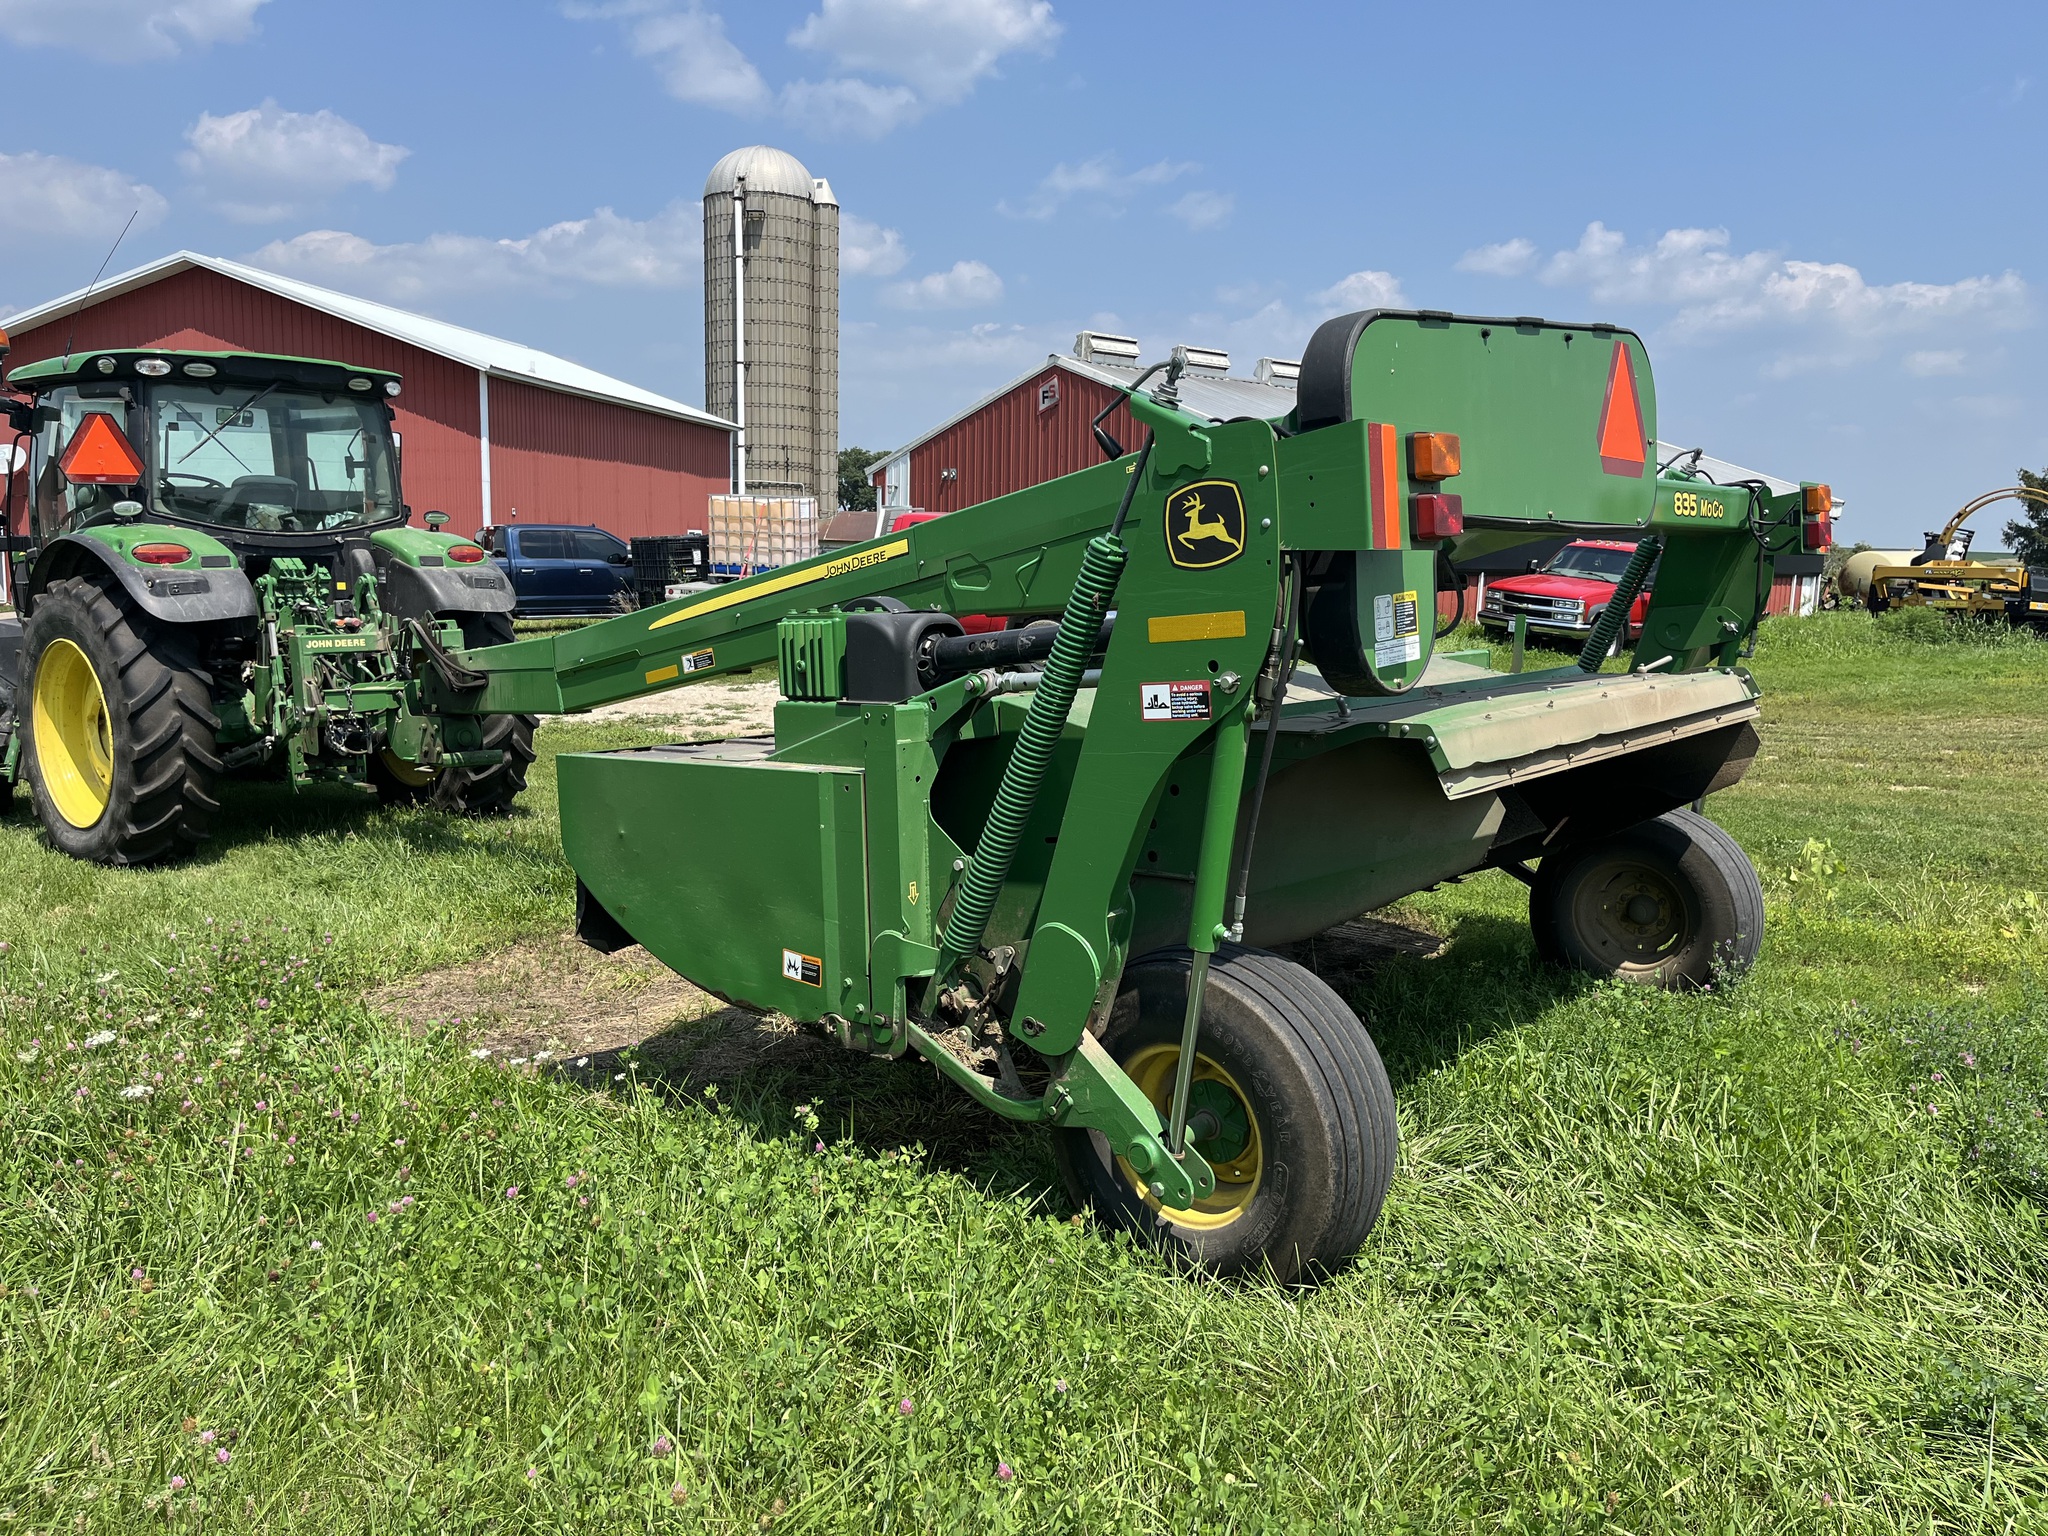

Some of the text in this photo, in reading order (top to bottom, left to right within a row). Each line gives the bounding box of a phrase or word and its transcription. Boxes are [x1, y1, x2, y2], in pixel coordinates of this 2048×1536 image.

[1042, 385, 1056, 404] FS
[1674, 491, 1723, 518] 835 MoCo
[824, 550, 887, 578] JOHN DEERE
[306, 639, 366, 648] JOHN DEERE
